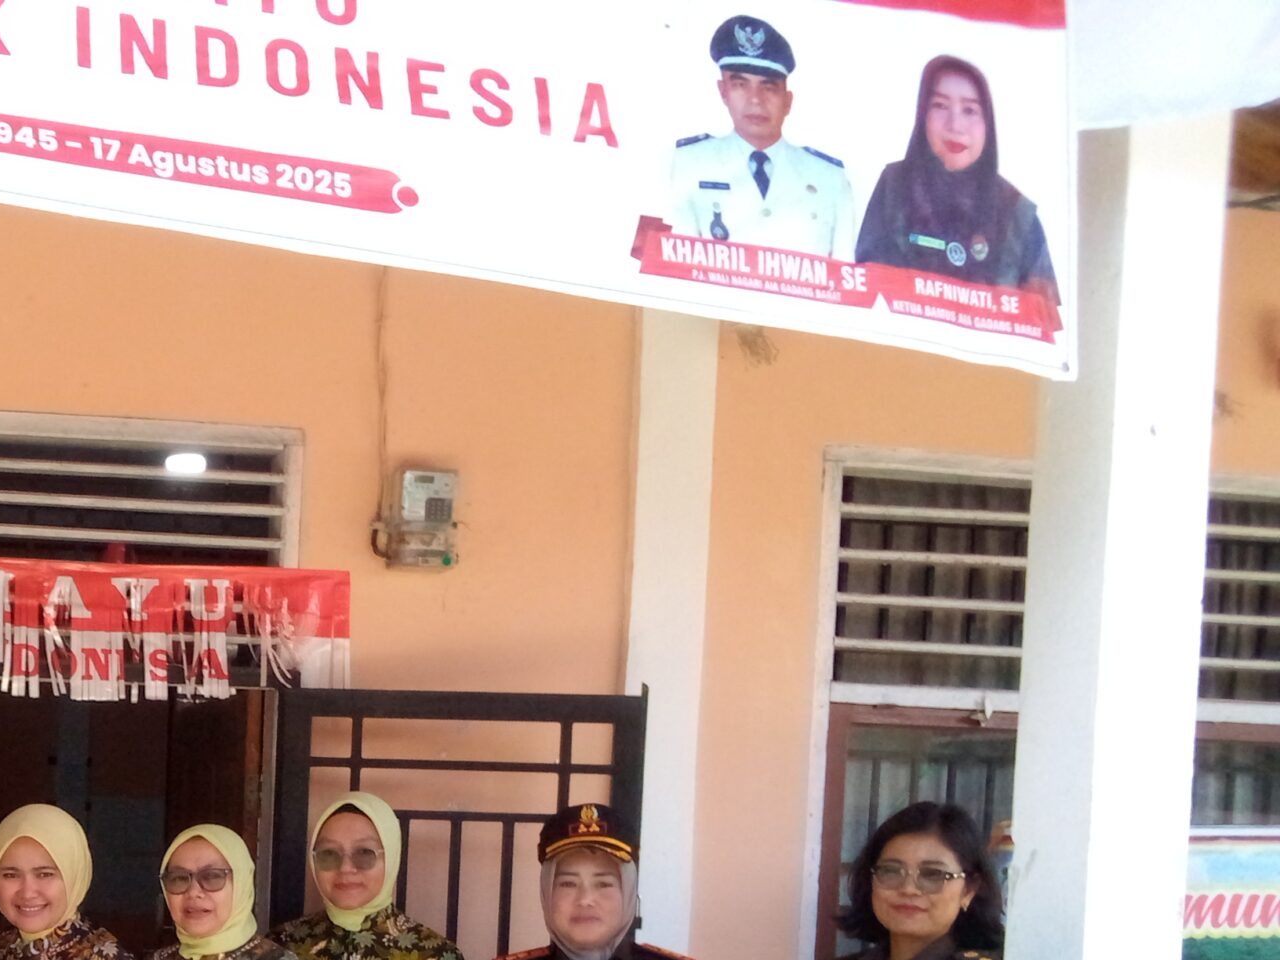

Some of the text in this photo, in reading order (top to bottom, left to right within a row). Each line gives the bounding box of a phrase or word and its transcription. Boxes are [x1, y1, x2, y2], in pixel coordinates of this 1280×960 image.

[76, 5, 619, 149] INDONESIA
[89, 136, 121, 162] 17
[128, 143, 270, 186] Agustus
[276, 163, 352, 198] 2025
[660, 236, 867, 293] KHAIRIL IHWAN, SE
[914, 276, 1019, 314] RAFNIWATI, SE
